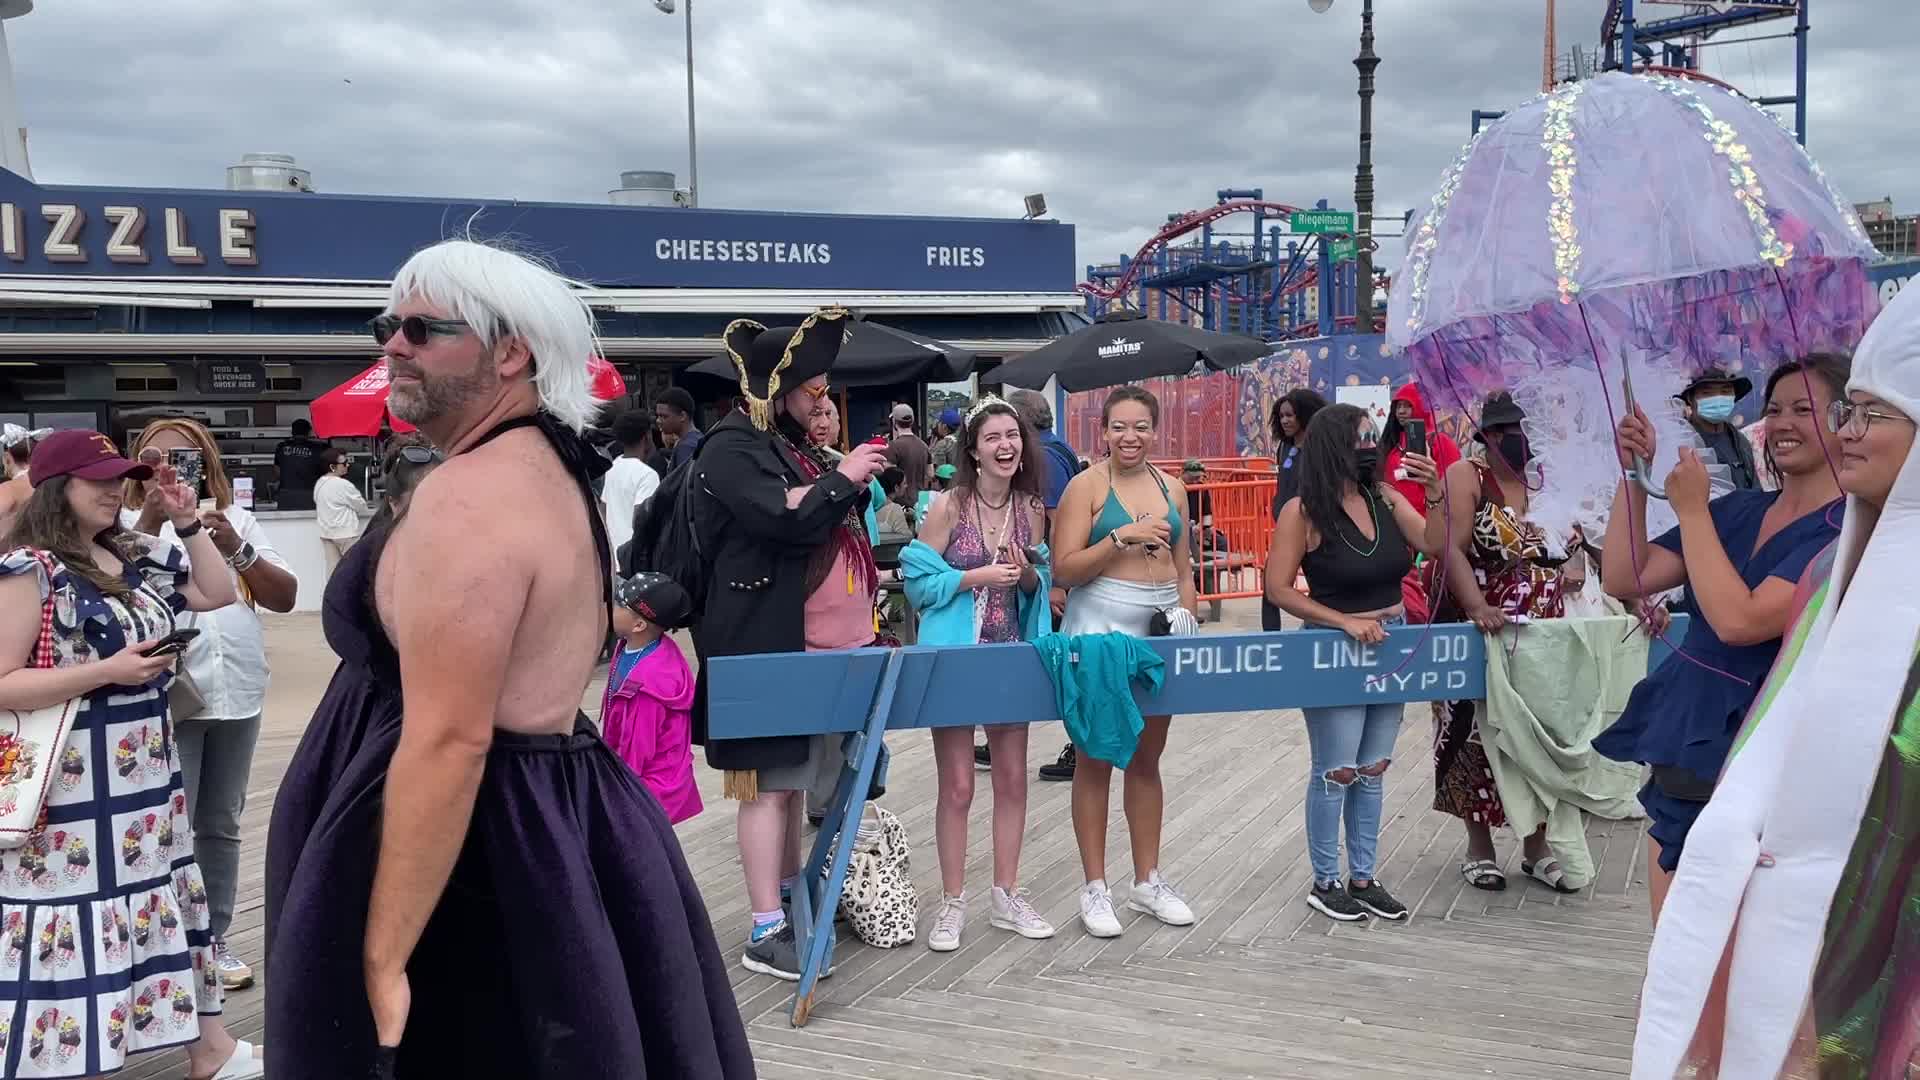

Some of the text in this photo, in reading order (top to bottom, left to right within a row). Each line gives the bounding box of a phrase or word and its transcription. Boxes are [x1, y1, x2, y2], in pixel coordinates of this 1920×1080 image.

[1298, 213, 1348, 228] Riegelmann
[0, 202, 258, 264] IZZLE
[655, 238, 831, 264] CHEESESTEAKS
[926, 246, 985, 267] FRIES
[1098, 342, 1141, 356] MAMITAS
[1175, 643, 1283, 676] POLICE
[1313, 640, 1378, 669] LINE
[1432, 635, 1468, 663] DO
[1364, 671, 1466, 694] NYPD
